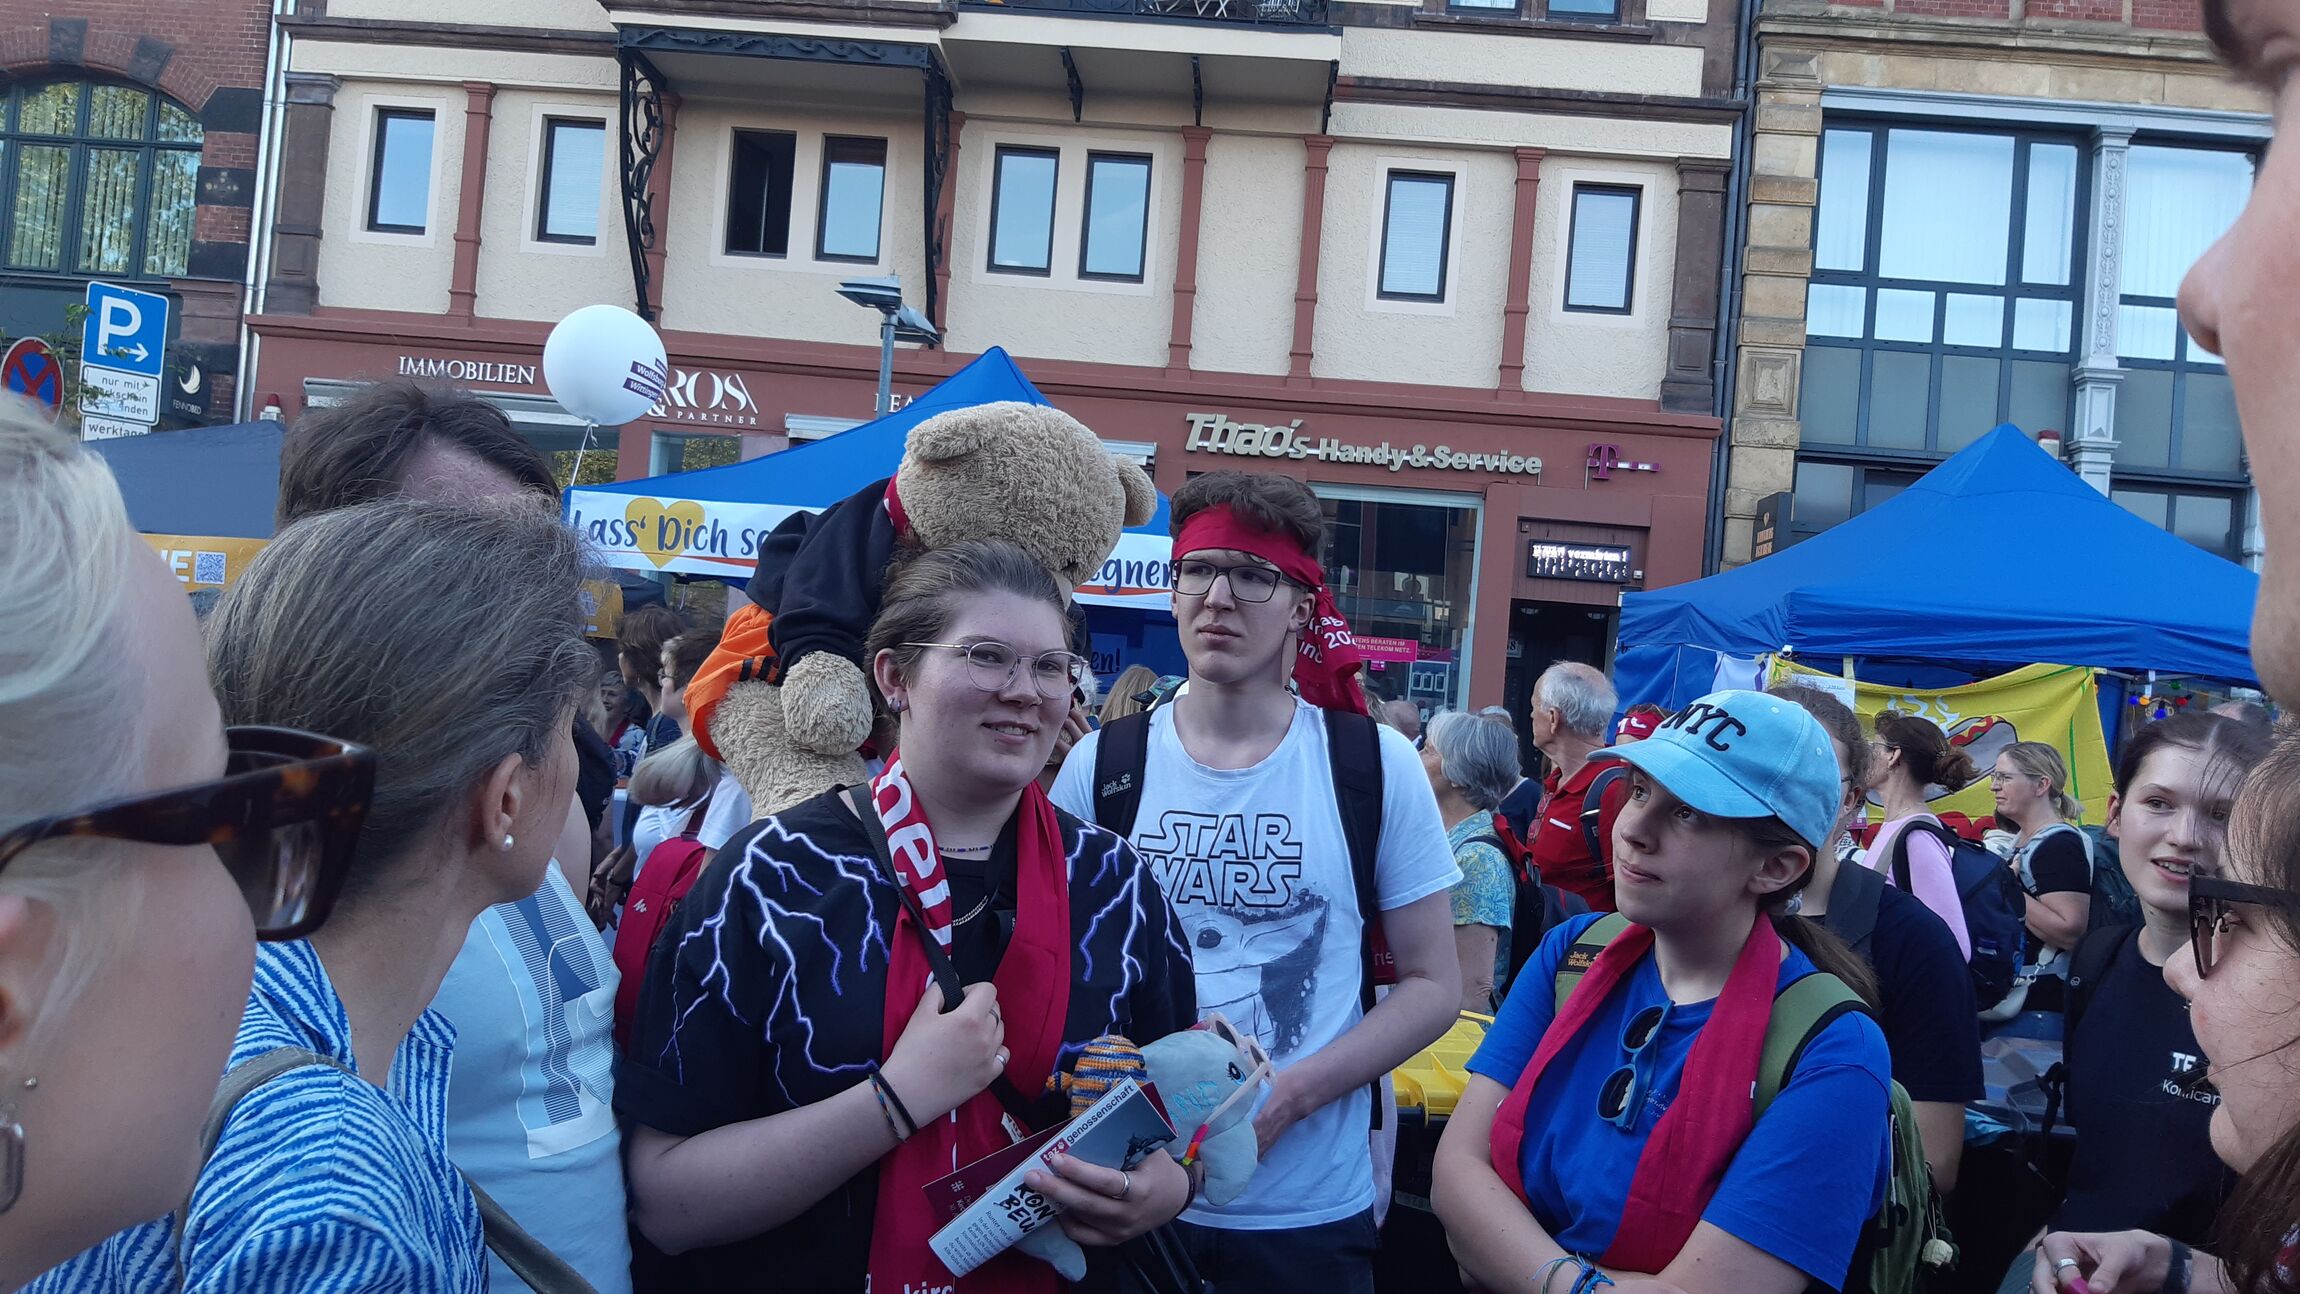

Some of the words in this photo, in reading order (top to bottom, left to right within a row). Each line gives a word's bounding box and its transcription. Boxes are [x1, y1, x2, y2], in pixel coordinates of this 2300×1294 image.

[97, 295, 142, 356] P
[101, 376, 119, 387] nur
[123, 380, 140, 390] mit
[399, 356, 537, 385] IMMOBILIEN
[677, 411, 757, 425] PARTNER
[657, 515, 728, 557] Dich
[1371, 638, 1397, 646] BERATEN
[1660, 703, 1747, 752] NYC
[1101, 780, 1118, 791] Jack
[1138, 810, 1303, 860] STAR
[1141, 853, 1301, 908] WARS
[1066, 1084, 1134, 1144] genossenschaft
